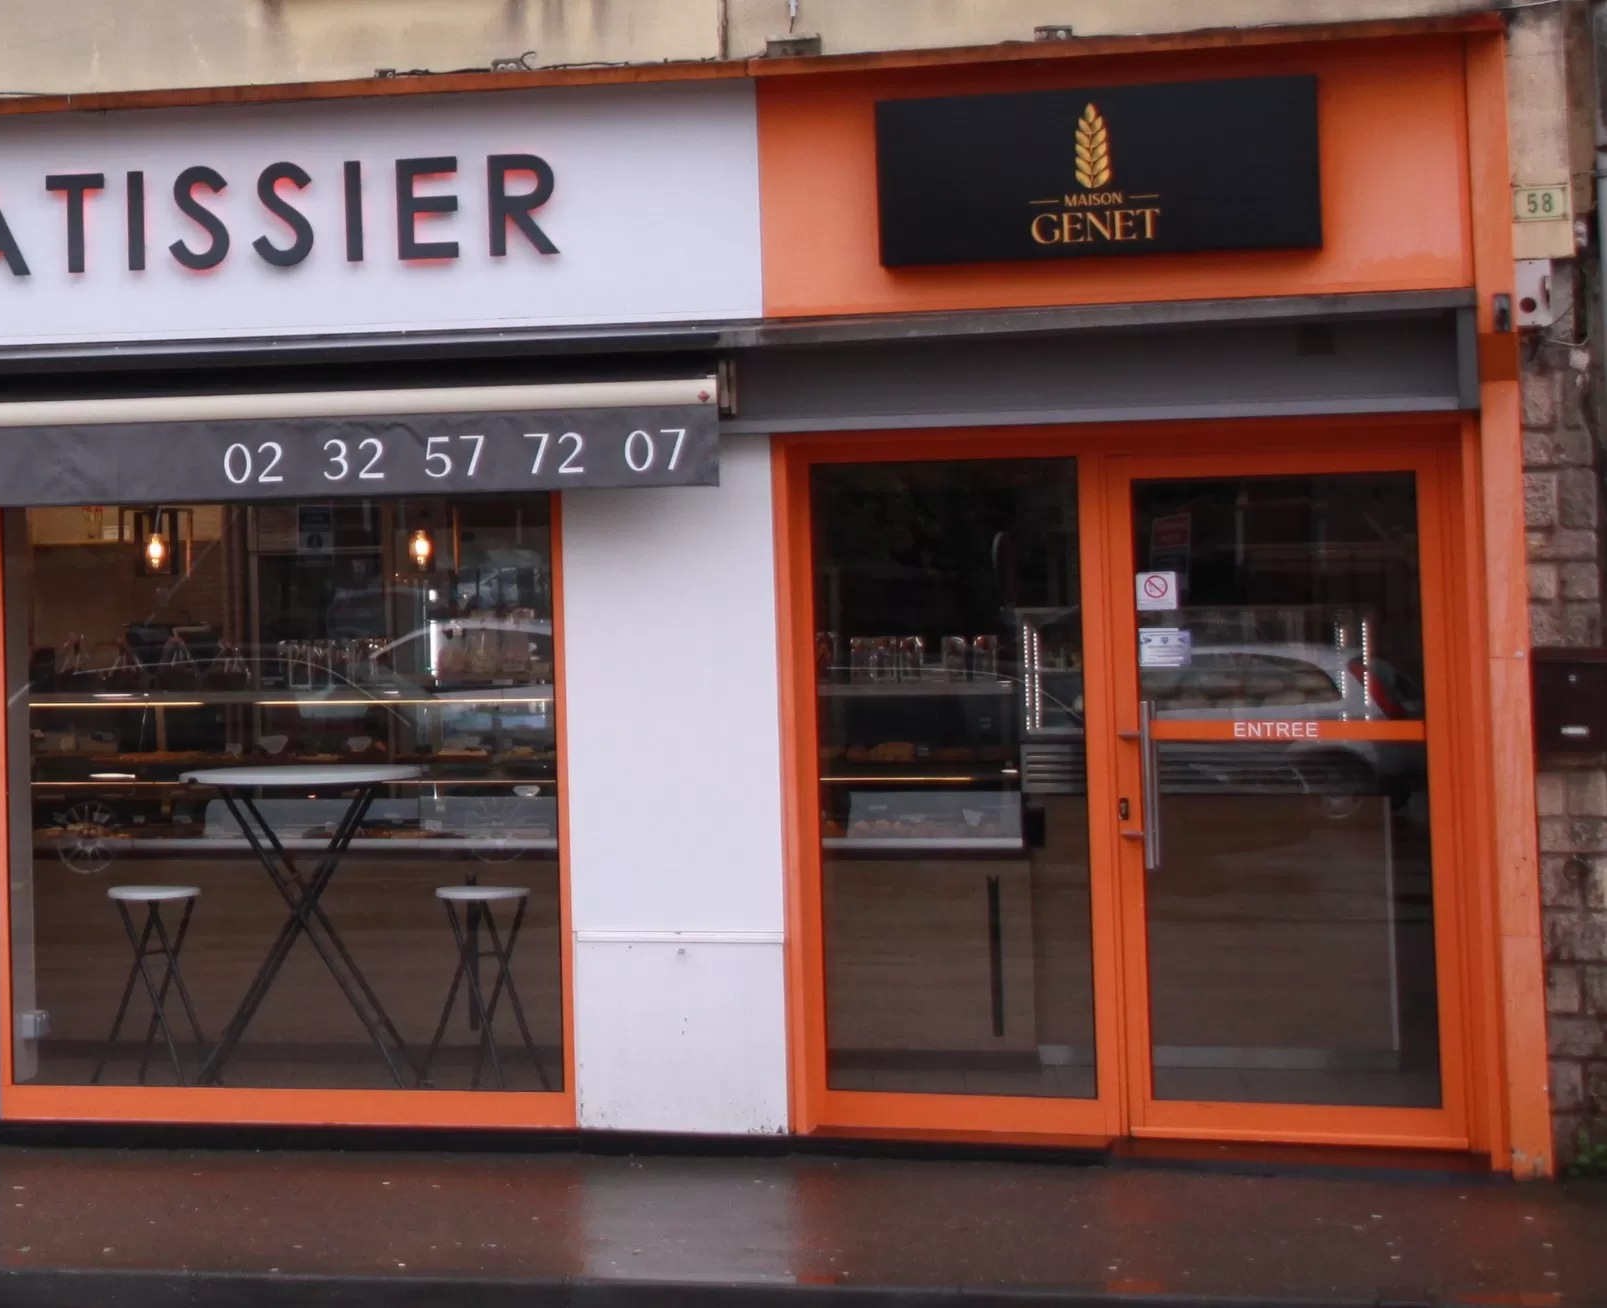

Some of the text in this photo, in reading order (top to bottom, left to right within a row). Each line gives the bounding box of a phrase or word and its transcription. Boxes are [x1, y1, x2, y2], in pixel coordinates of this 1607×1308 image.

[1063, 191, 1123, 207] MAISON
[1526, 192, 1554, 214] 58
[1030, 207, 1161, 244] GENET
[222, 427, 687, 485] 02 32 57 72 07
[1233, 722, 1319, 738] ENTREE
